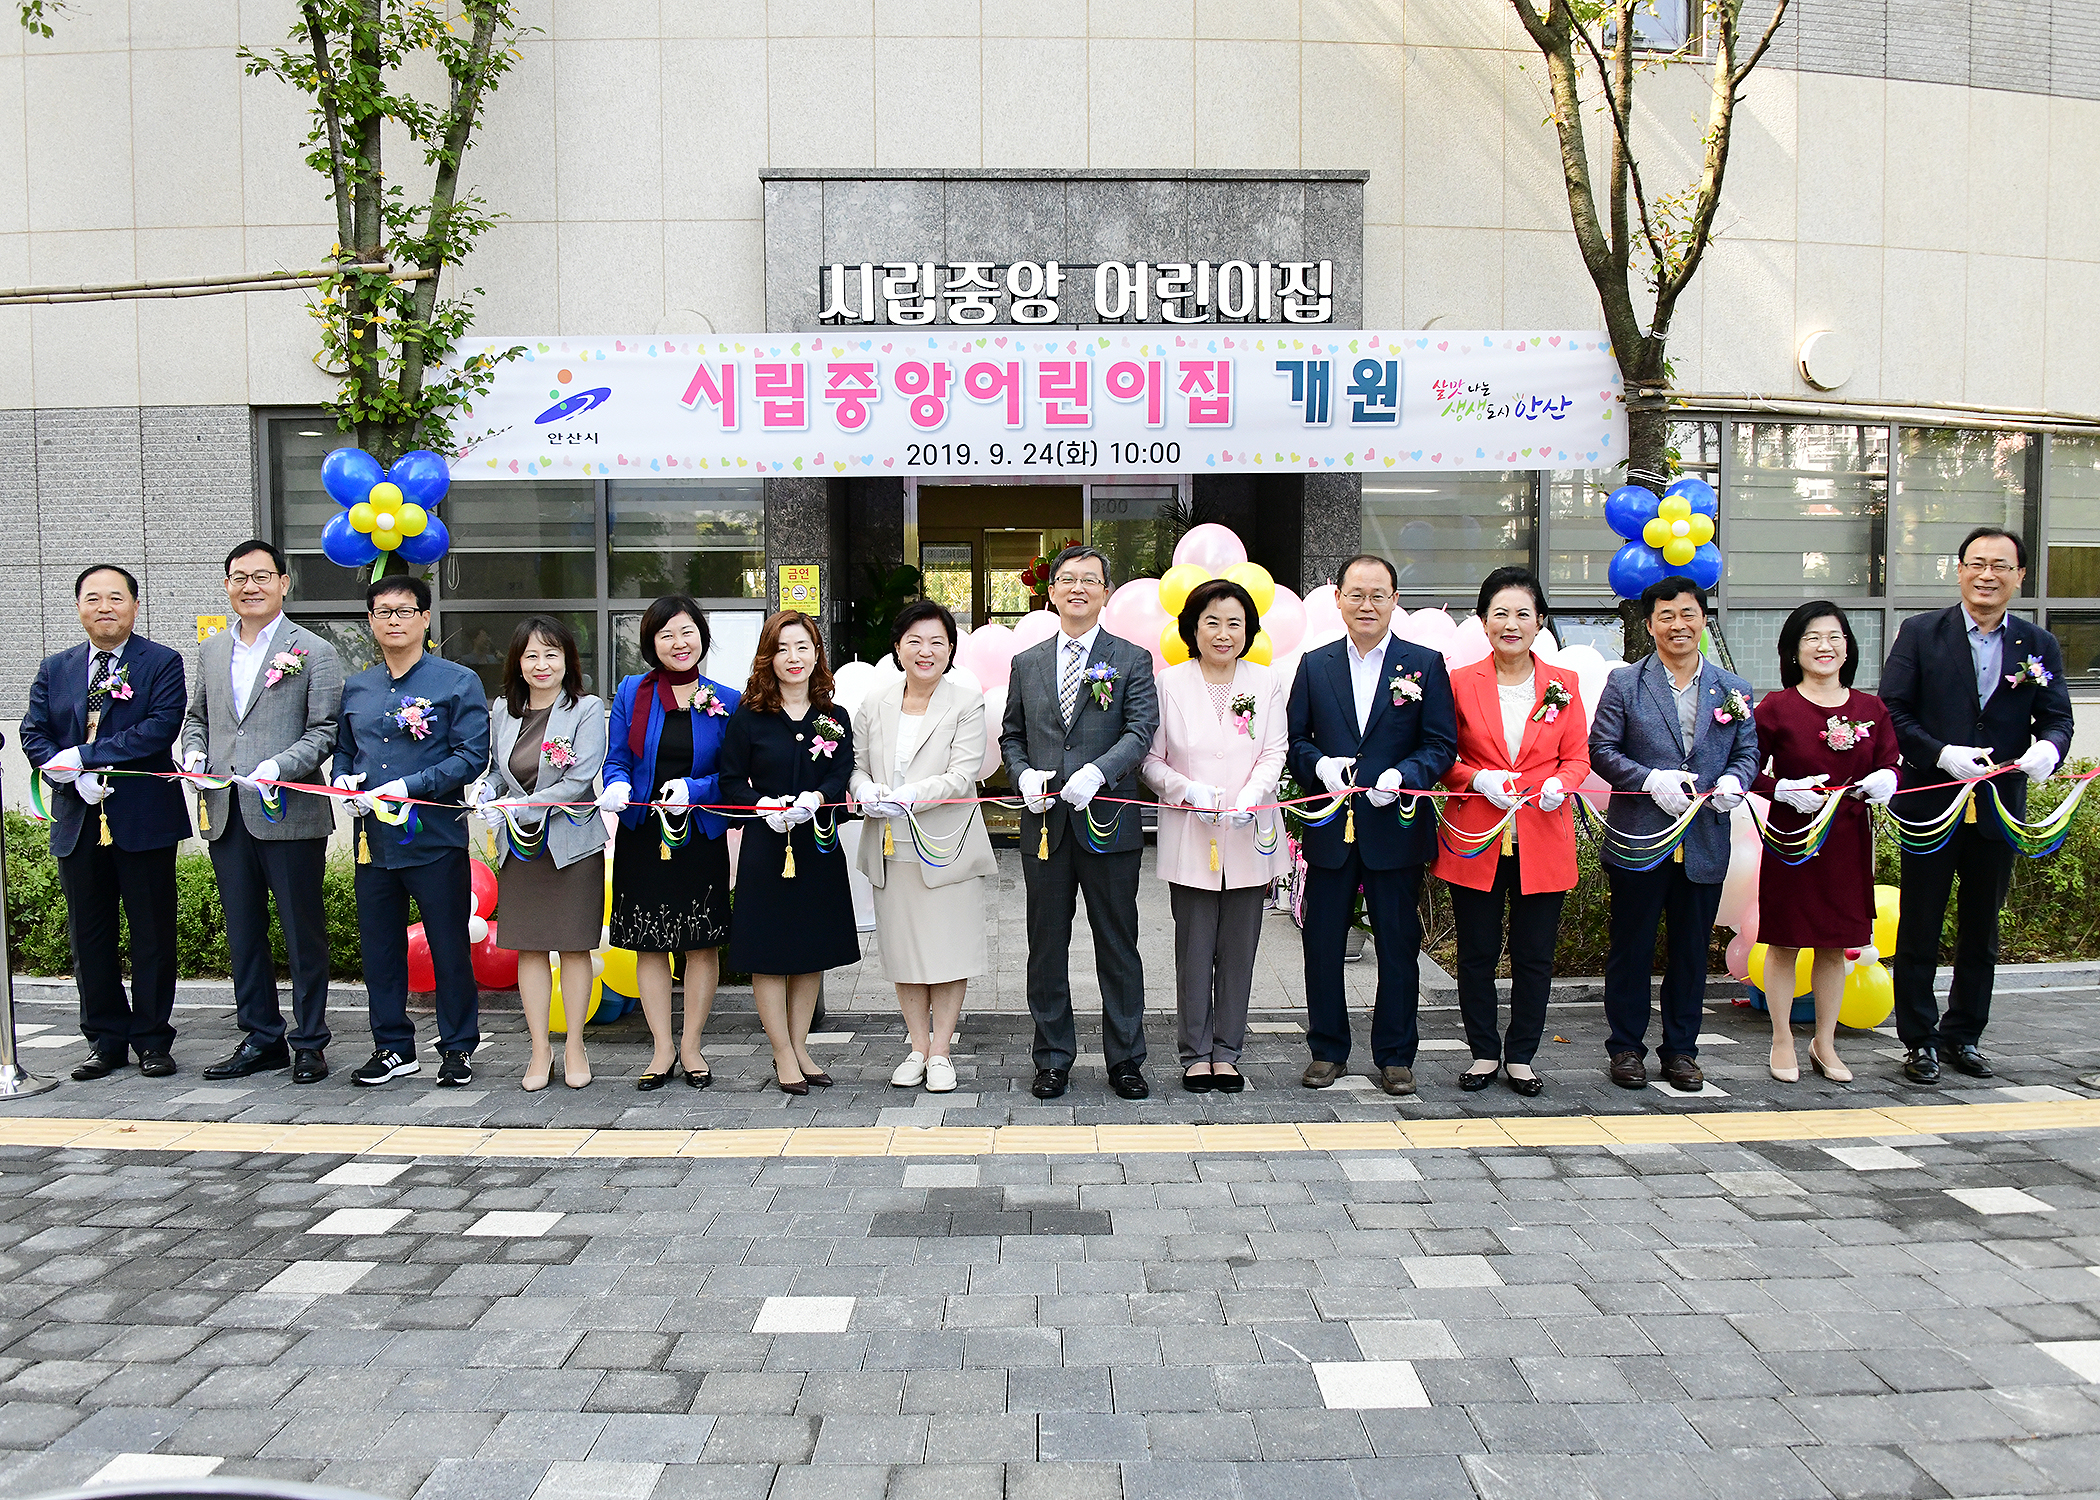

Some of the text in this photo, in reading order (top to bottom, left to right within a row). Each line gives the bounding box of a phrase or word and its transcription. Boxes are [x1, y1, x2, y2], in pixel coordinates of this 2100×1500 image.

[818, 260, 1333, 324] 시립중앙 어린이집
[681, 358, 1401, 430] 시립중앙어린이집 개원
[1515, 394, 1573, 421] 안산
[547, 432, 598, 445] 안산시
[906, 440, 1181, 467] 2019. 9. 24(화) 10:00
[787, 567, 809, 580] 금연
